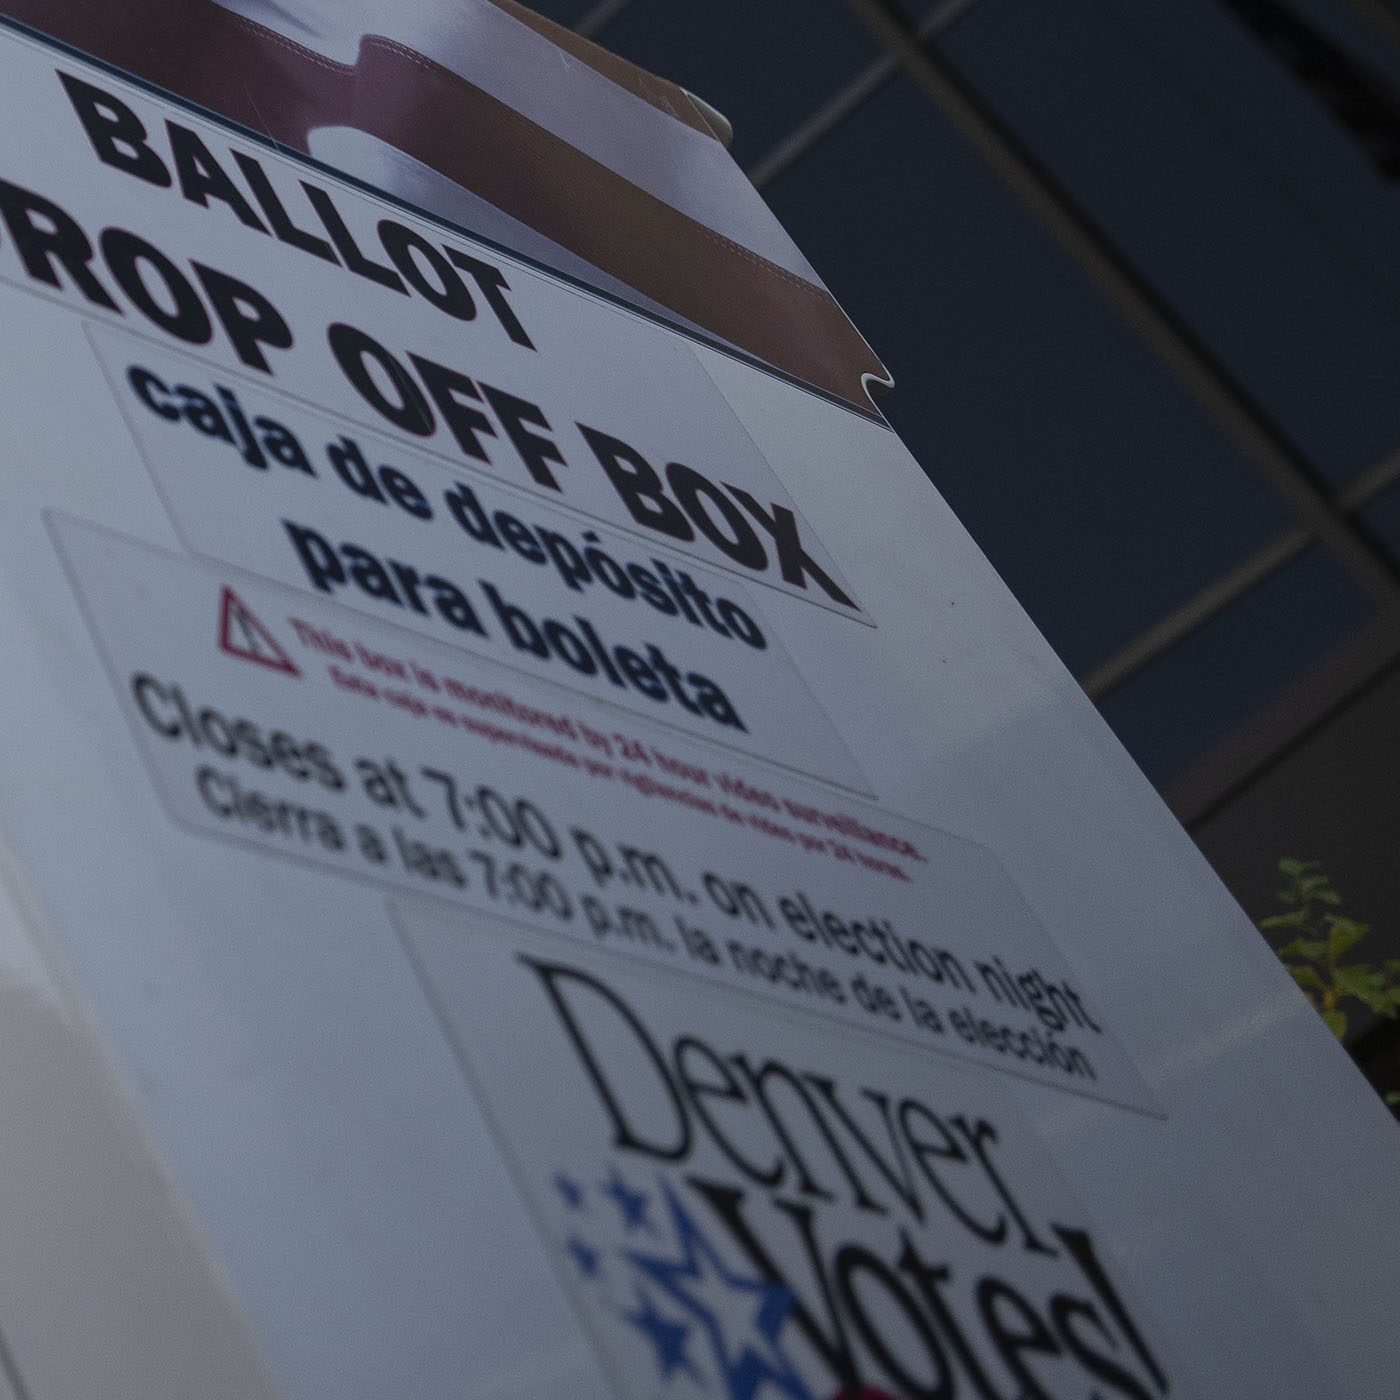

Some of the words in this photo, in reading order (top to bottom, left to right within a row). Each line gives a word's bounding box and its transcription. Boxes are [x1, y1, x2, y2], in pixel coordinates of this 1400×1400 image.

[57, 70, 536, 351] BALLOT
[126, 365, 317, 475] caja
[325, 436, 434, 520] de
[445, 483, 767, 650] depósito
[327, 322, 568, 493] OFF
[575, 422, 861, 612] BOX
[282, 520, 477, 633] para
[481, 579, 750, 735] boleta
[130, 672, 348, 794] Closes
[354, 758, 427, 820] at
[420, 767, 564, 863] 7:00
[569, 827, 700, 906] p.m.
[701, 871, 776, 930] on
[777, 892, 977, 995] election
[973, 961, 1103, 1035] night
[195, 765, 348, 853] Cierra
[356, 824, 389, 865] a
[392, 828, 469, 890] las
[468, 849, 575, 923] 7:00
[579, 894, 677, 953] p.m.
[674, 916, 723, 967] la
[726, 940, 848, 1006] noche
[850, 973, 903, 1023] de
[899, 986, 946, 1036] la
[515, 952, 1059, 1260] Denver
